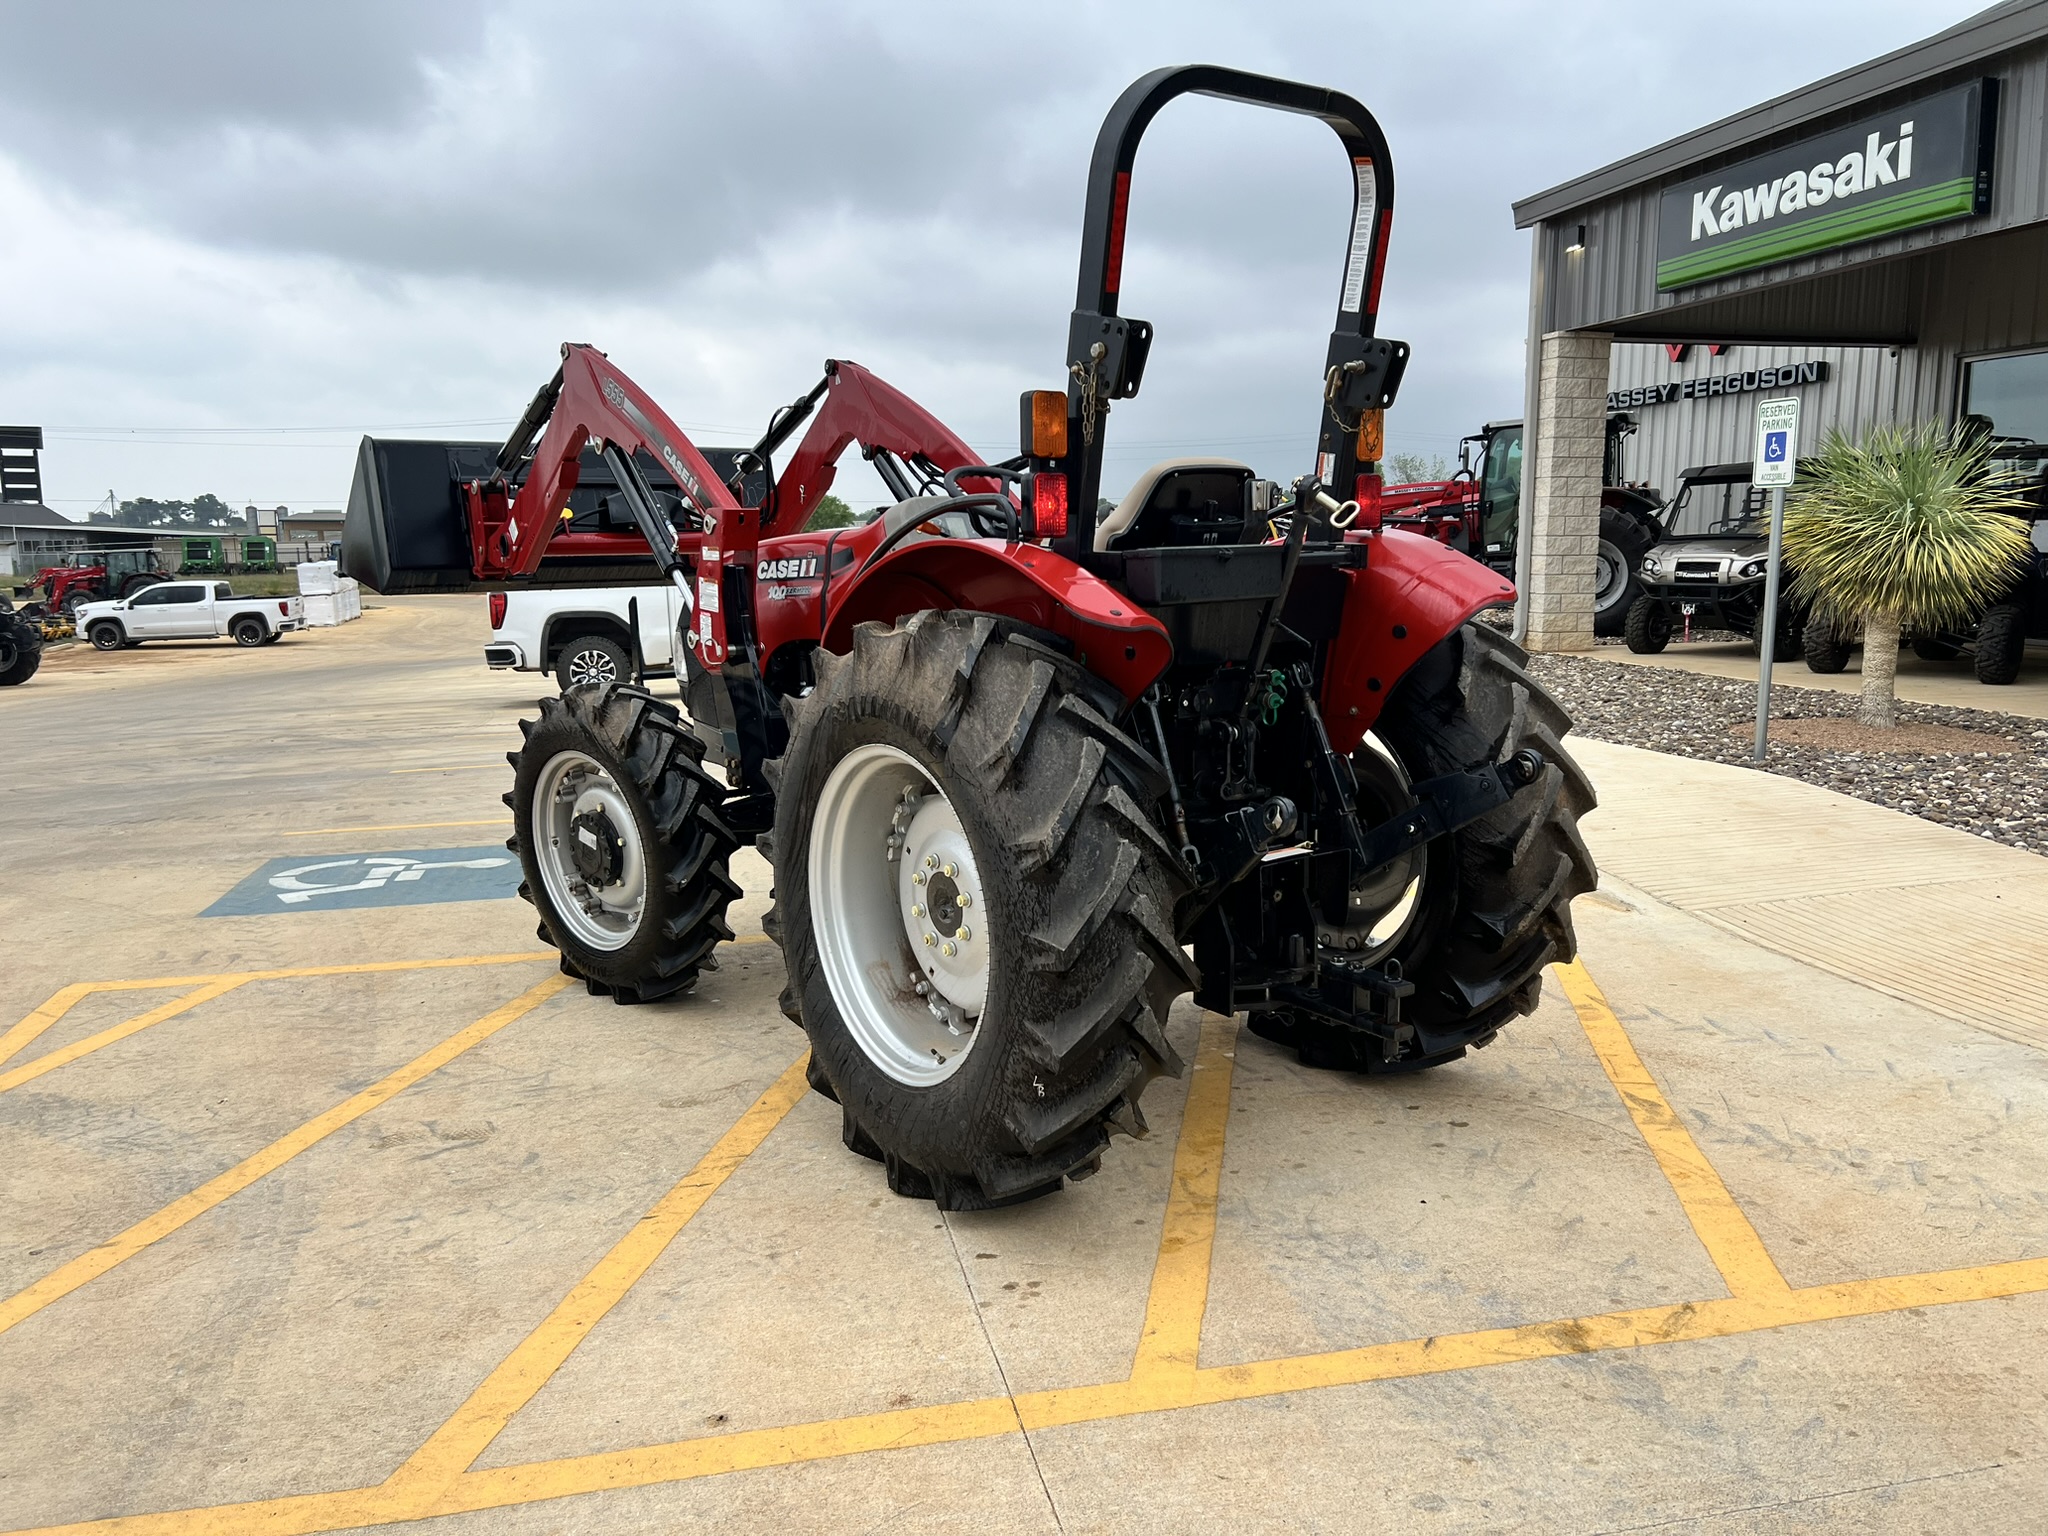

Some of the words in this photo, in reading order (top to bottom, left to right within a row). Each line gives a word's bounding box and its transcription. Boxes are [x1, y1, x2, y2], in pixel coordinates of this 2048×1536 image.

[1691, 120, 1914, 242] Kawasaki
[1606, 383, 1672, 409] ASSEY
[1681, 361, 1818, 400] FERGUSON
[1761, 404, 1796, 418] RESERVED
[1762, 418, 1793, 431] PARKING
[663, 445, 691, 481] CASE
[1761, 472, 1786, 480] ACCESSIBLE
[757, 559, 800, 580] CASE
